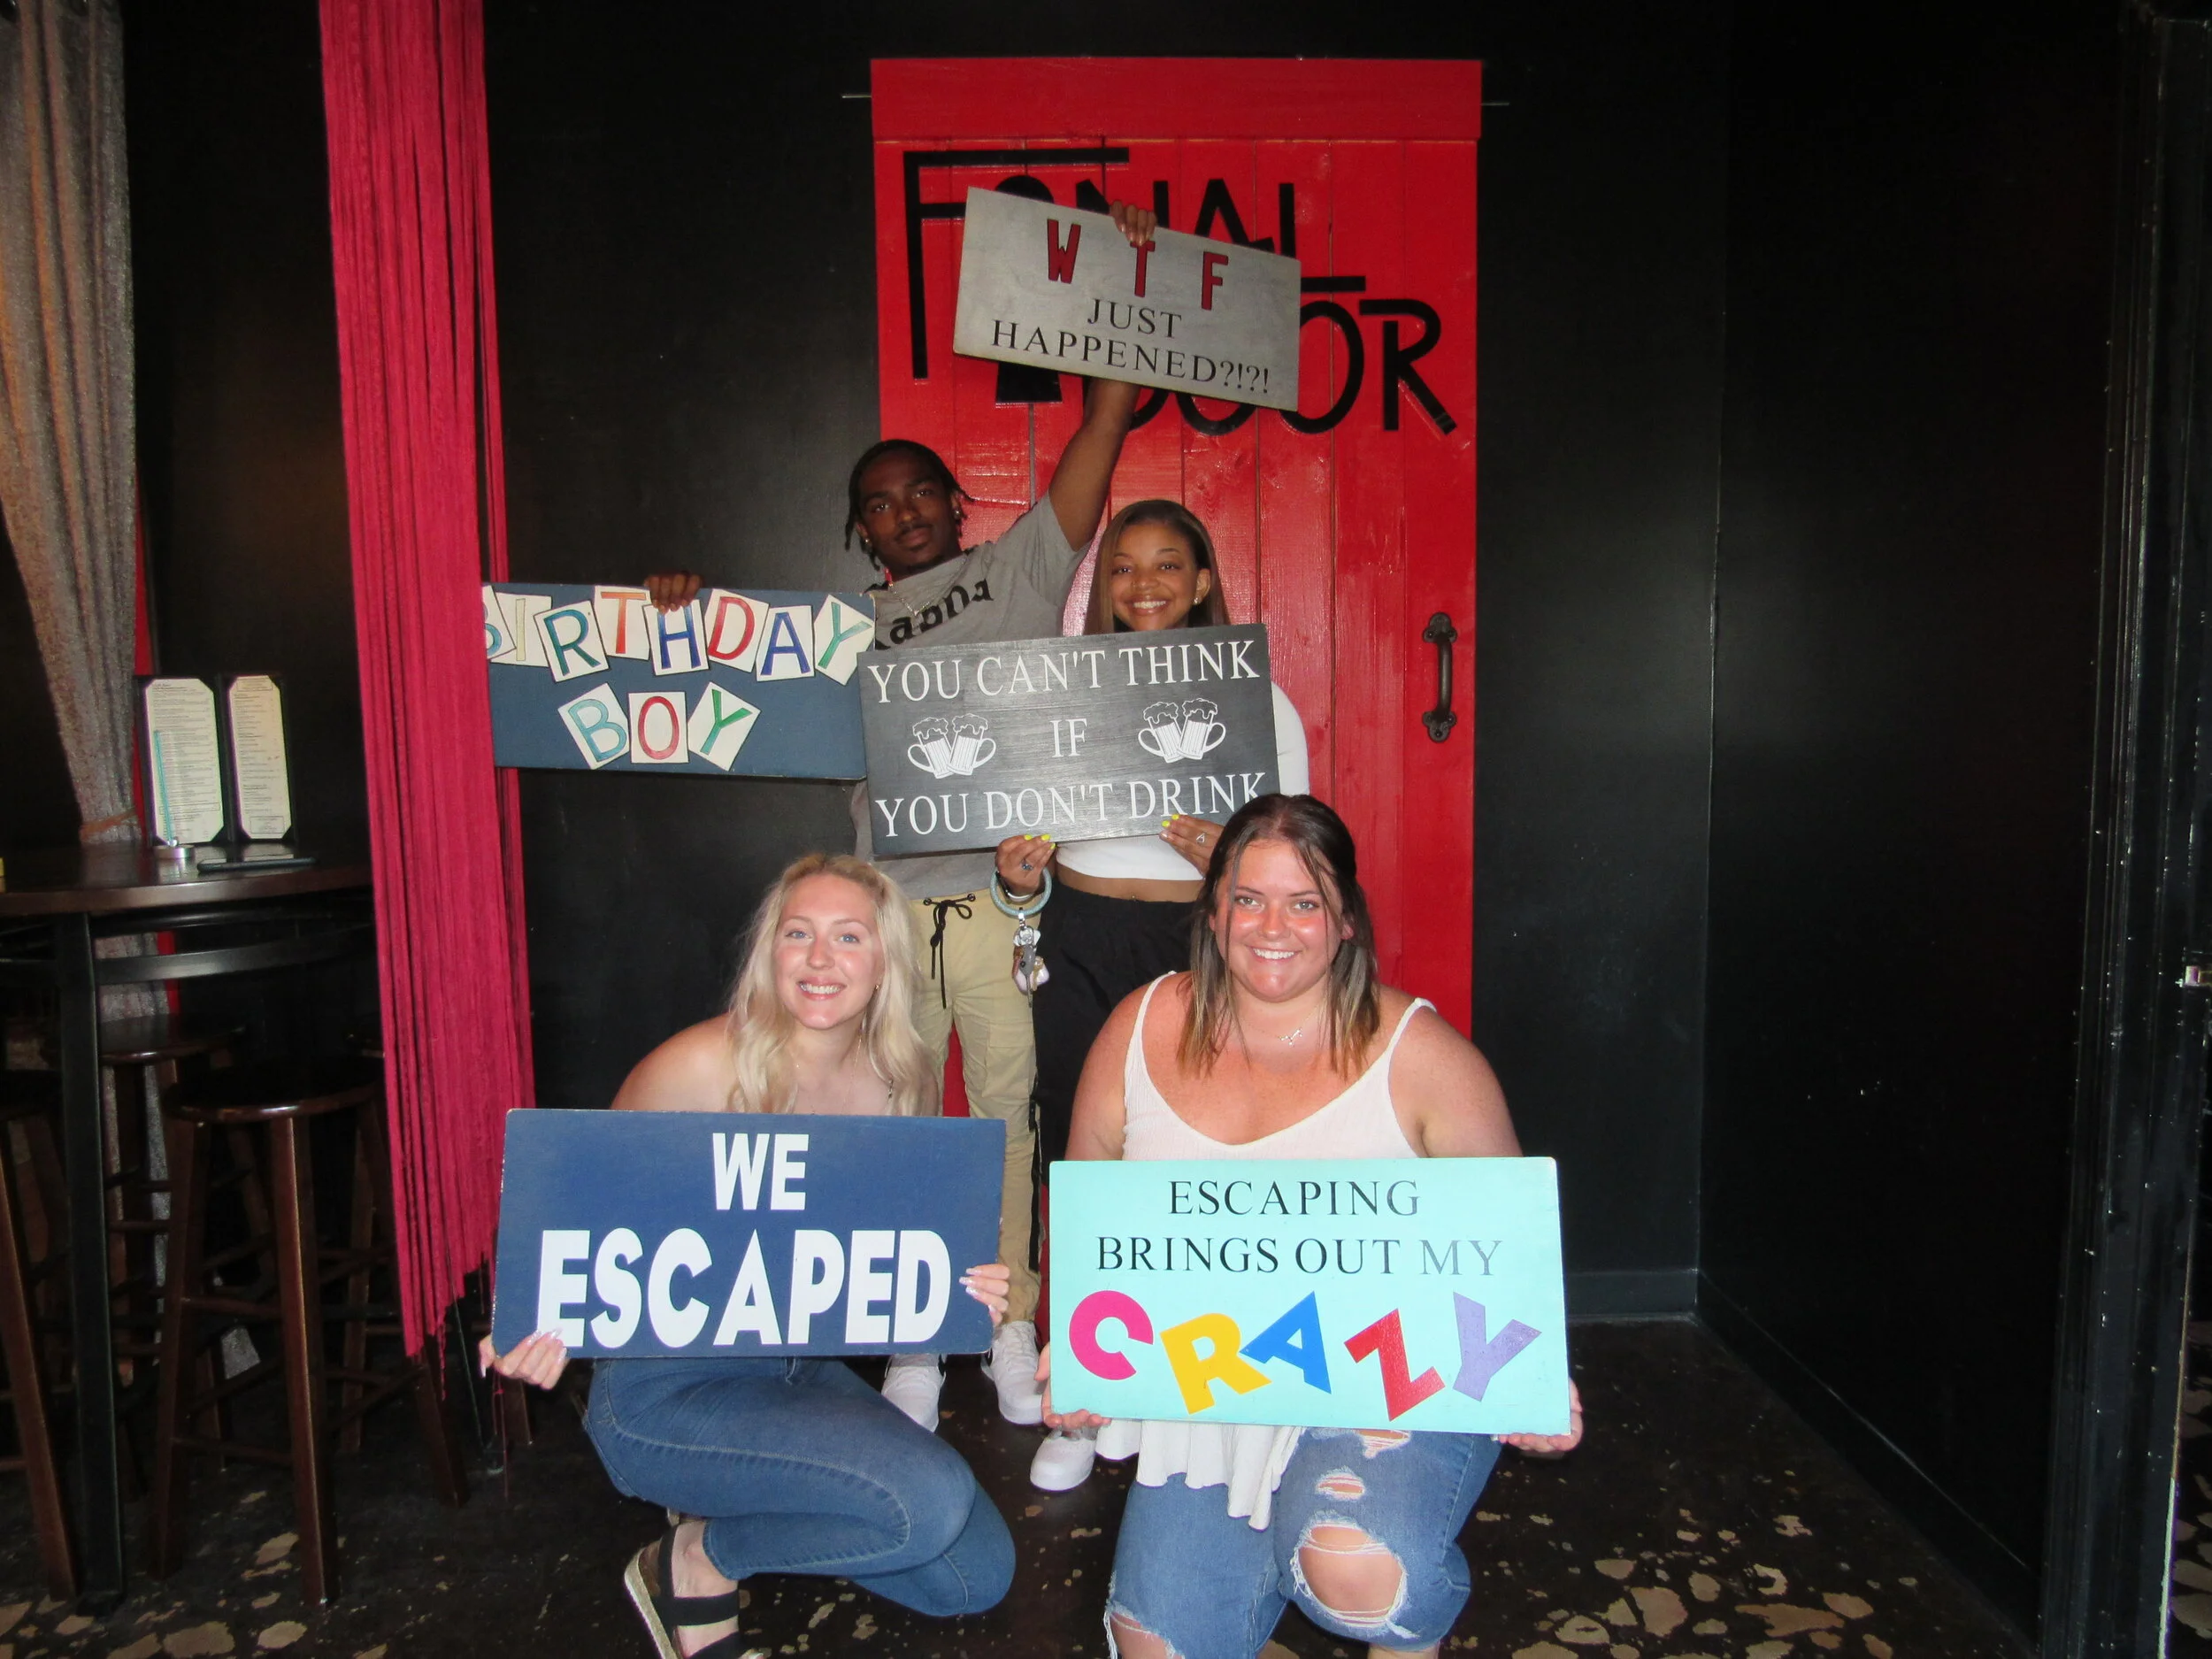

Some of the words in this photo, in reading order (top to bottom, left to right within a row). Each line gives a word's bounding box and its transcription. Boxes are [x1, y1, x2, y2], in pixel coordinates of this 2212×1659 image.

[1087, 297, 1183, 340] JUST
[991, 319, 1270, 395] HAPPENED?!?!
[867, 659, 962, 704] YOU
[977, 649, 1106, 696] CAN'T
[1118, 640, 1260, 685] THINK
[567, 689, 753, 763] BOY
[1050, 718, 1088, 758] IF
[875, 793, 970, 838] YOU
[984, 783, 1114, 830] DON'T
[1126, 772, 1266, 818] DRINK
[712, 1133, 810, 1211] WE
[1168, 1179, 1420, 1217] ESCAPING
[537, 1227, 952, 1349] ESCAPED
[1096, 1236, 1279, 1274] BRINGS
[1295, 1238, 1401, 1276] OUT
[1419, 1240, 1503, 1277] MY
[1068, 1290, 1543, 1423] CRAZY
